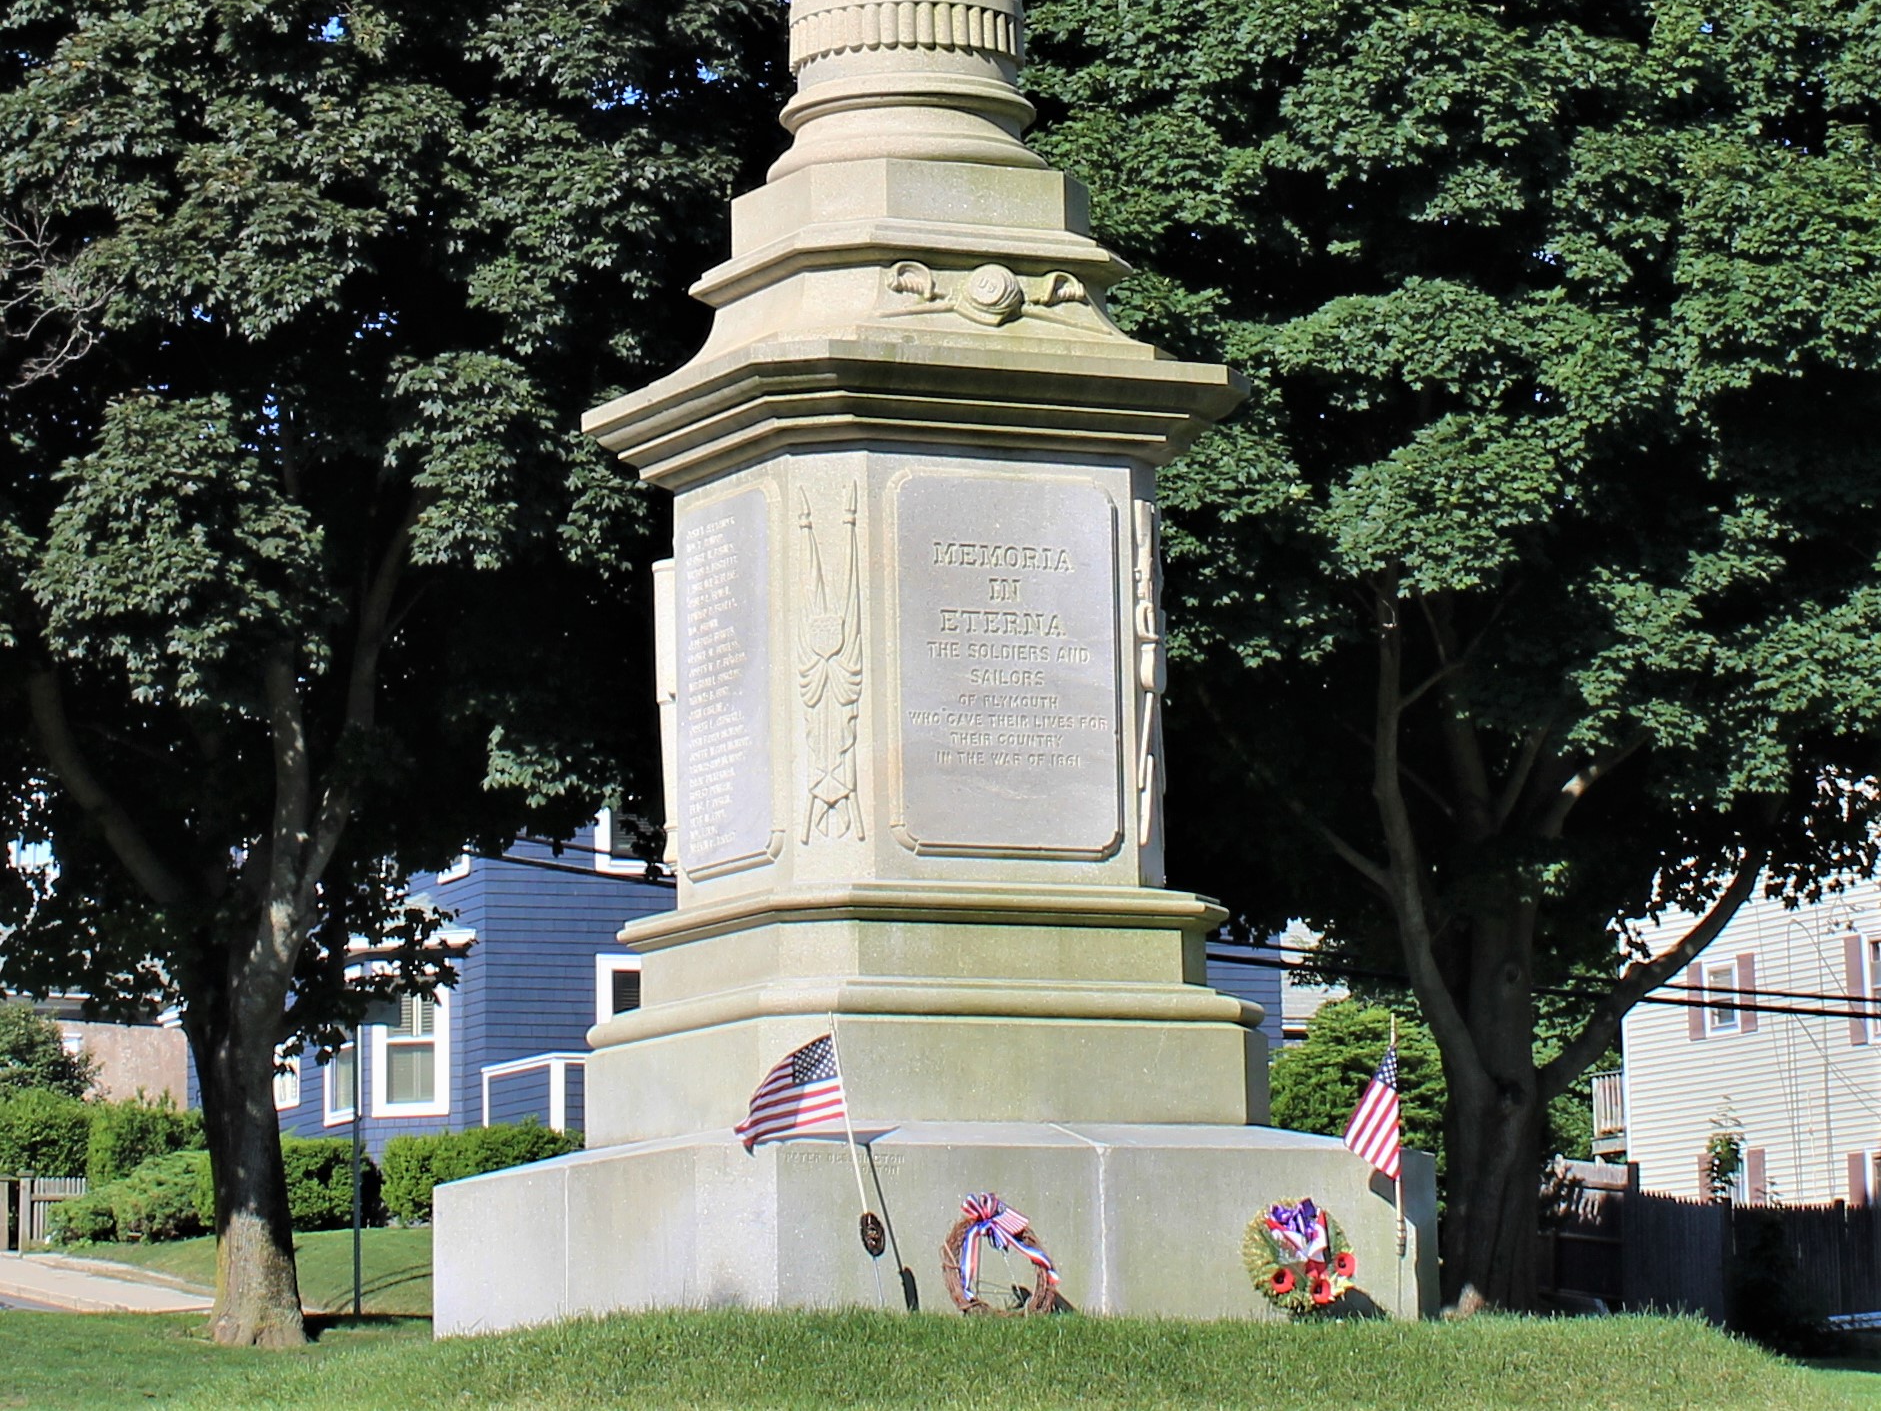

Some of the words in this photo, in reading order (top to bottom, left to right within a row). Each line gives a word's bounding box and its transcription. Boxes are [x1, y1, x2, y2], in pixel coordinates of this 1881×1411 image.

[932, 541, 1075, 573] MEMORIA
[988, 578, 1021, 602] IN
[939, 609, 1067, 638] ETERNA
[926, 640, 960, 658] THE
[967, 642, 1050, 661] SOLDIERS
[1056, 646, 1091, 664] AND
[970, 668, 1045, 687] SAILORS
[958, 694, 977, 707] OF
[983, 694, 1059, 709] PLYMOUTH
[908, 711, 941, 726] WHO
[946, 712, 983, 727] GAVE
[988, 713, 1028, 728] THEIR
[1034, 715, 1074, 730] LIVES
[1079, 716, 1108, 731] FOR
[950, 731, 991, 746] THEIR
[997, 733, 1063, 748] COUNTRY
[935, 750, 951, 765] IN
[957, 751, 984, 765] THE
[991, 752, 1022, 766] WAR
[1027, 753, 1045, 767] OF
